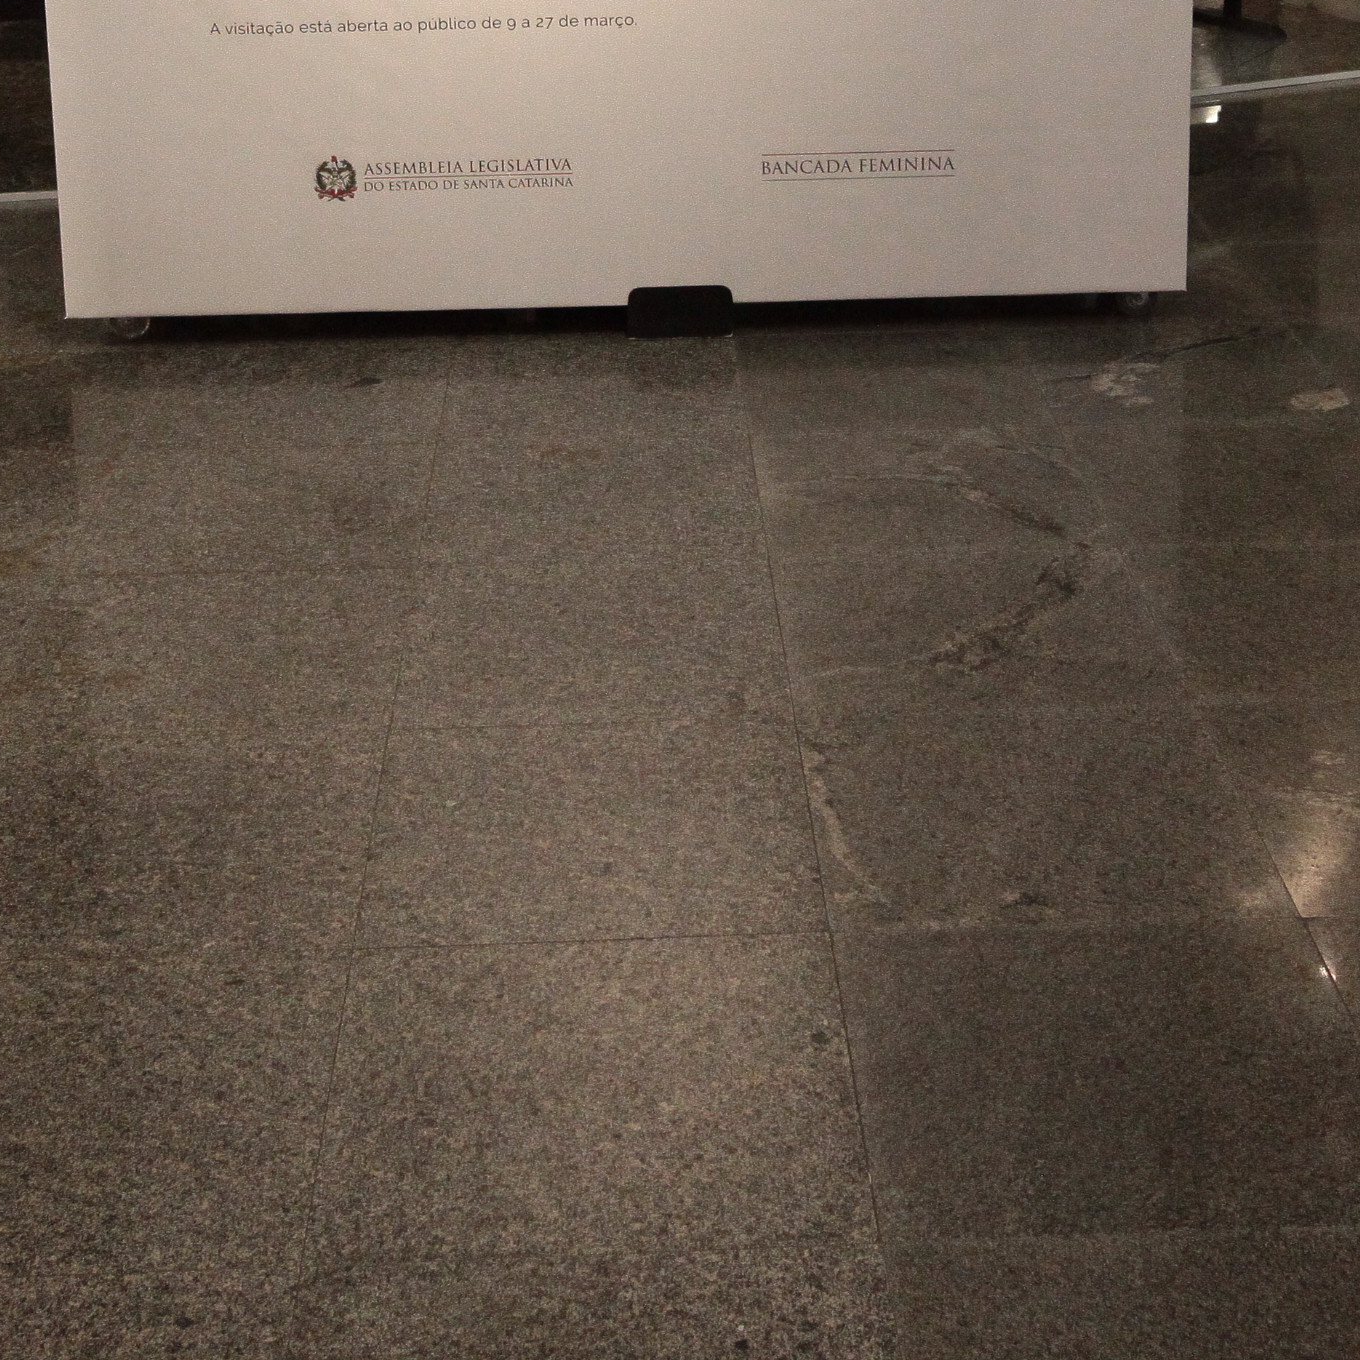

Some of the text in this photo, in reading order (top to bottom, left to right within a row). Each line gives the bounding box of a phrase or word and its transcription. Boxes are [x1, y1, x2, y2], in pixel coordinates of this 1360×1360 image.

[209, 14, 638, 37] A visitação está aberta ao público de 9 a 27 de março.
[364, 158, 573, 176] ASSEMBLEIA LEGISLATIVA
[761, 156, 956, 175] BANCADA FEMININA
[364, 176, 574, 192] DO ESTADO DE SANTA CATARINA
